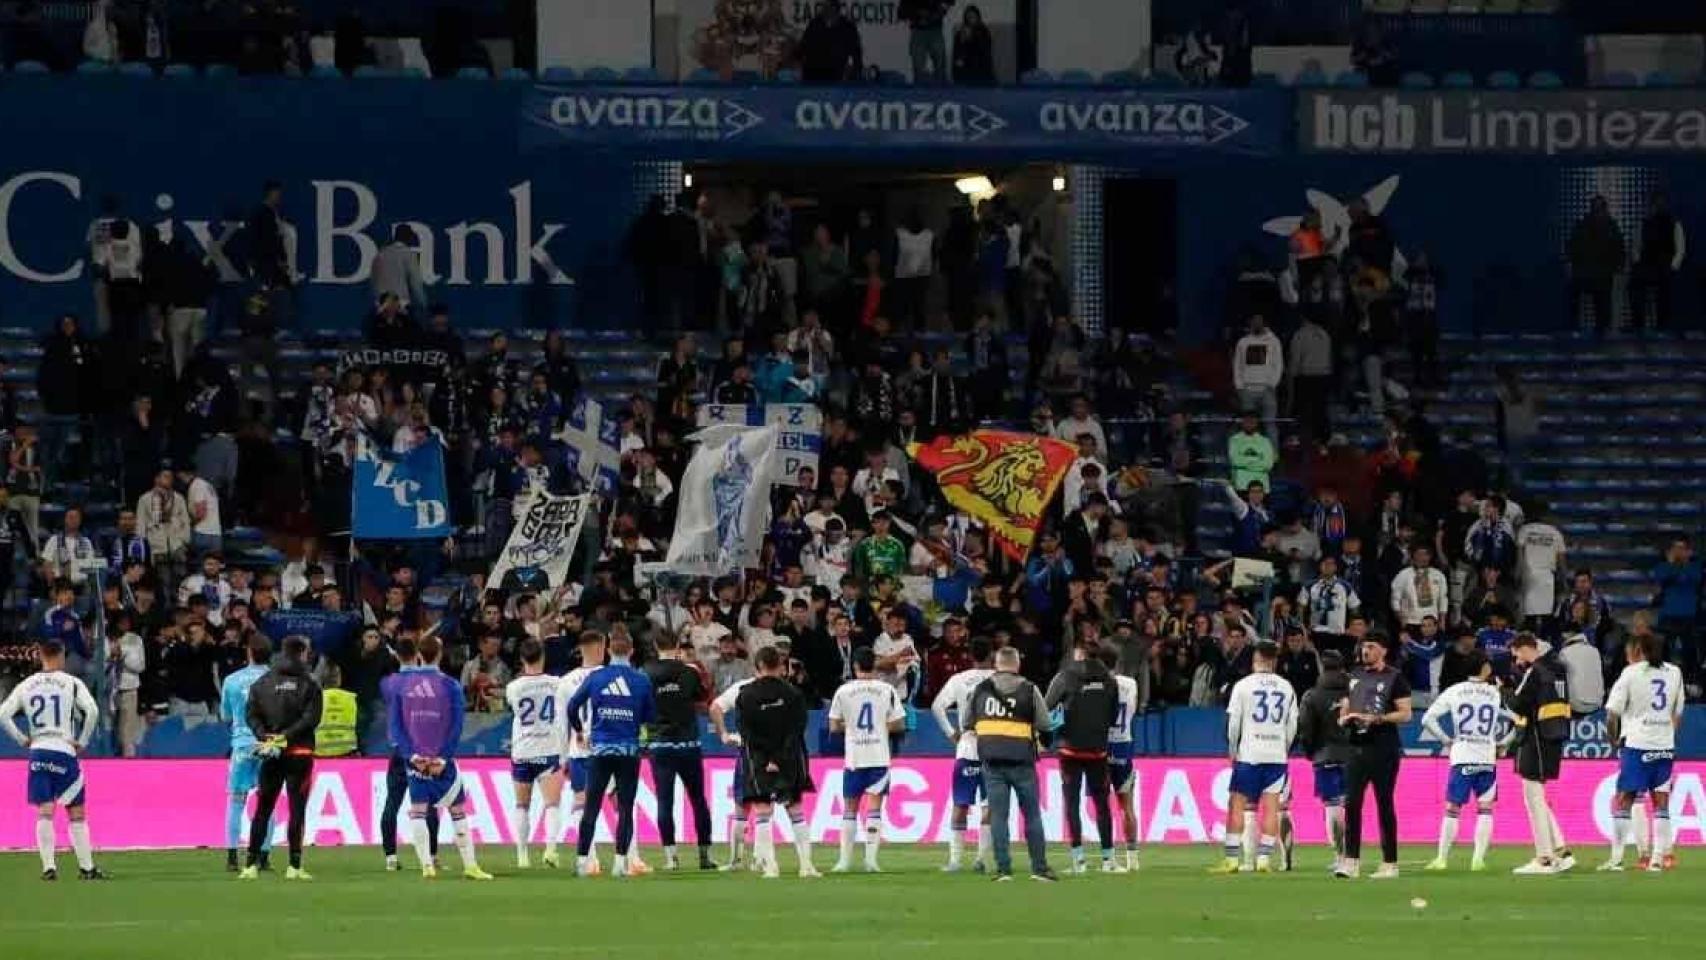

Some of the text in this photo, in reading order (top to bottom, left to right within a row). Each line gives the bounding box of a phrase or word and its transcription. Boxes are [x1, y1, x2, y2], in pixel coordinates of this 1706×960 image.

[550, 95, 719, 126] avanza
[795, 99, 963, 130] avanza
[1039, 102, 1204, 131] avanza
[1313, 95, 1706, 155] bcb Limpieza
[0, 169, 576, 285] CixBank
[30, 694, 61, 728] 21
[518, 695, 556, 726] 24
[1252, 690, 1286, 724] 33
[1651, 678, 1667, 711] 3
[857, 701, 875, 735] 4
[1458, 703, 1494, 736] 29
